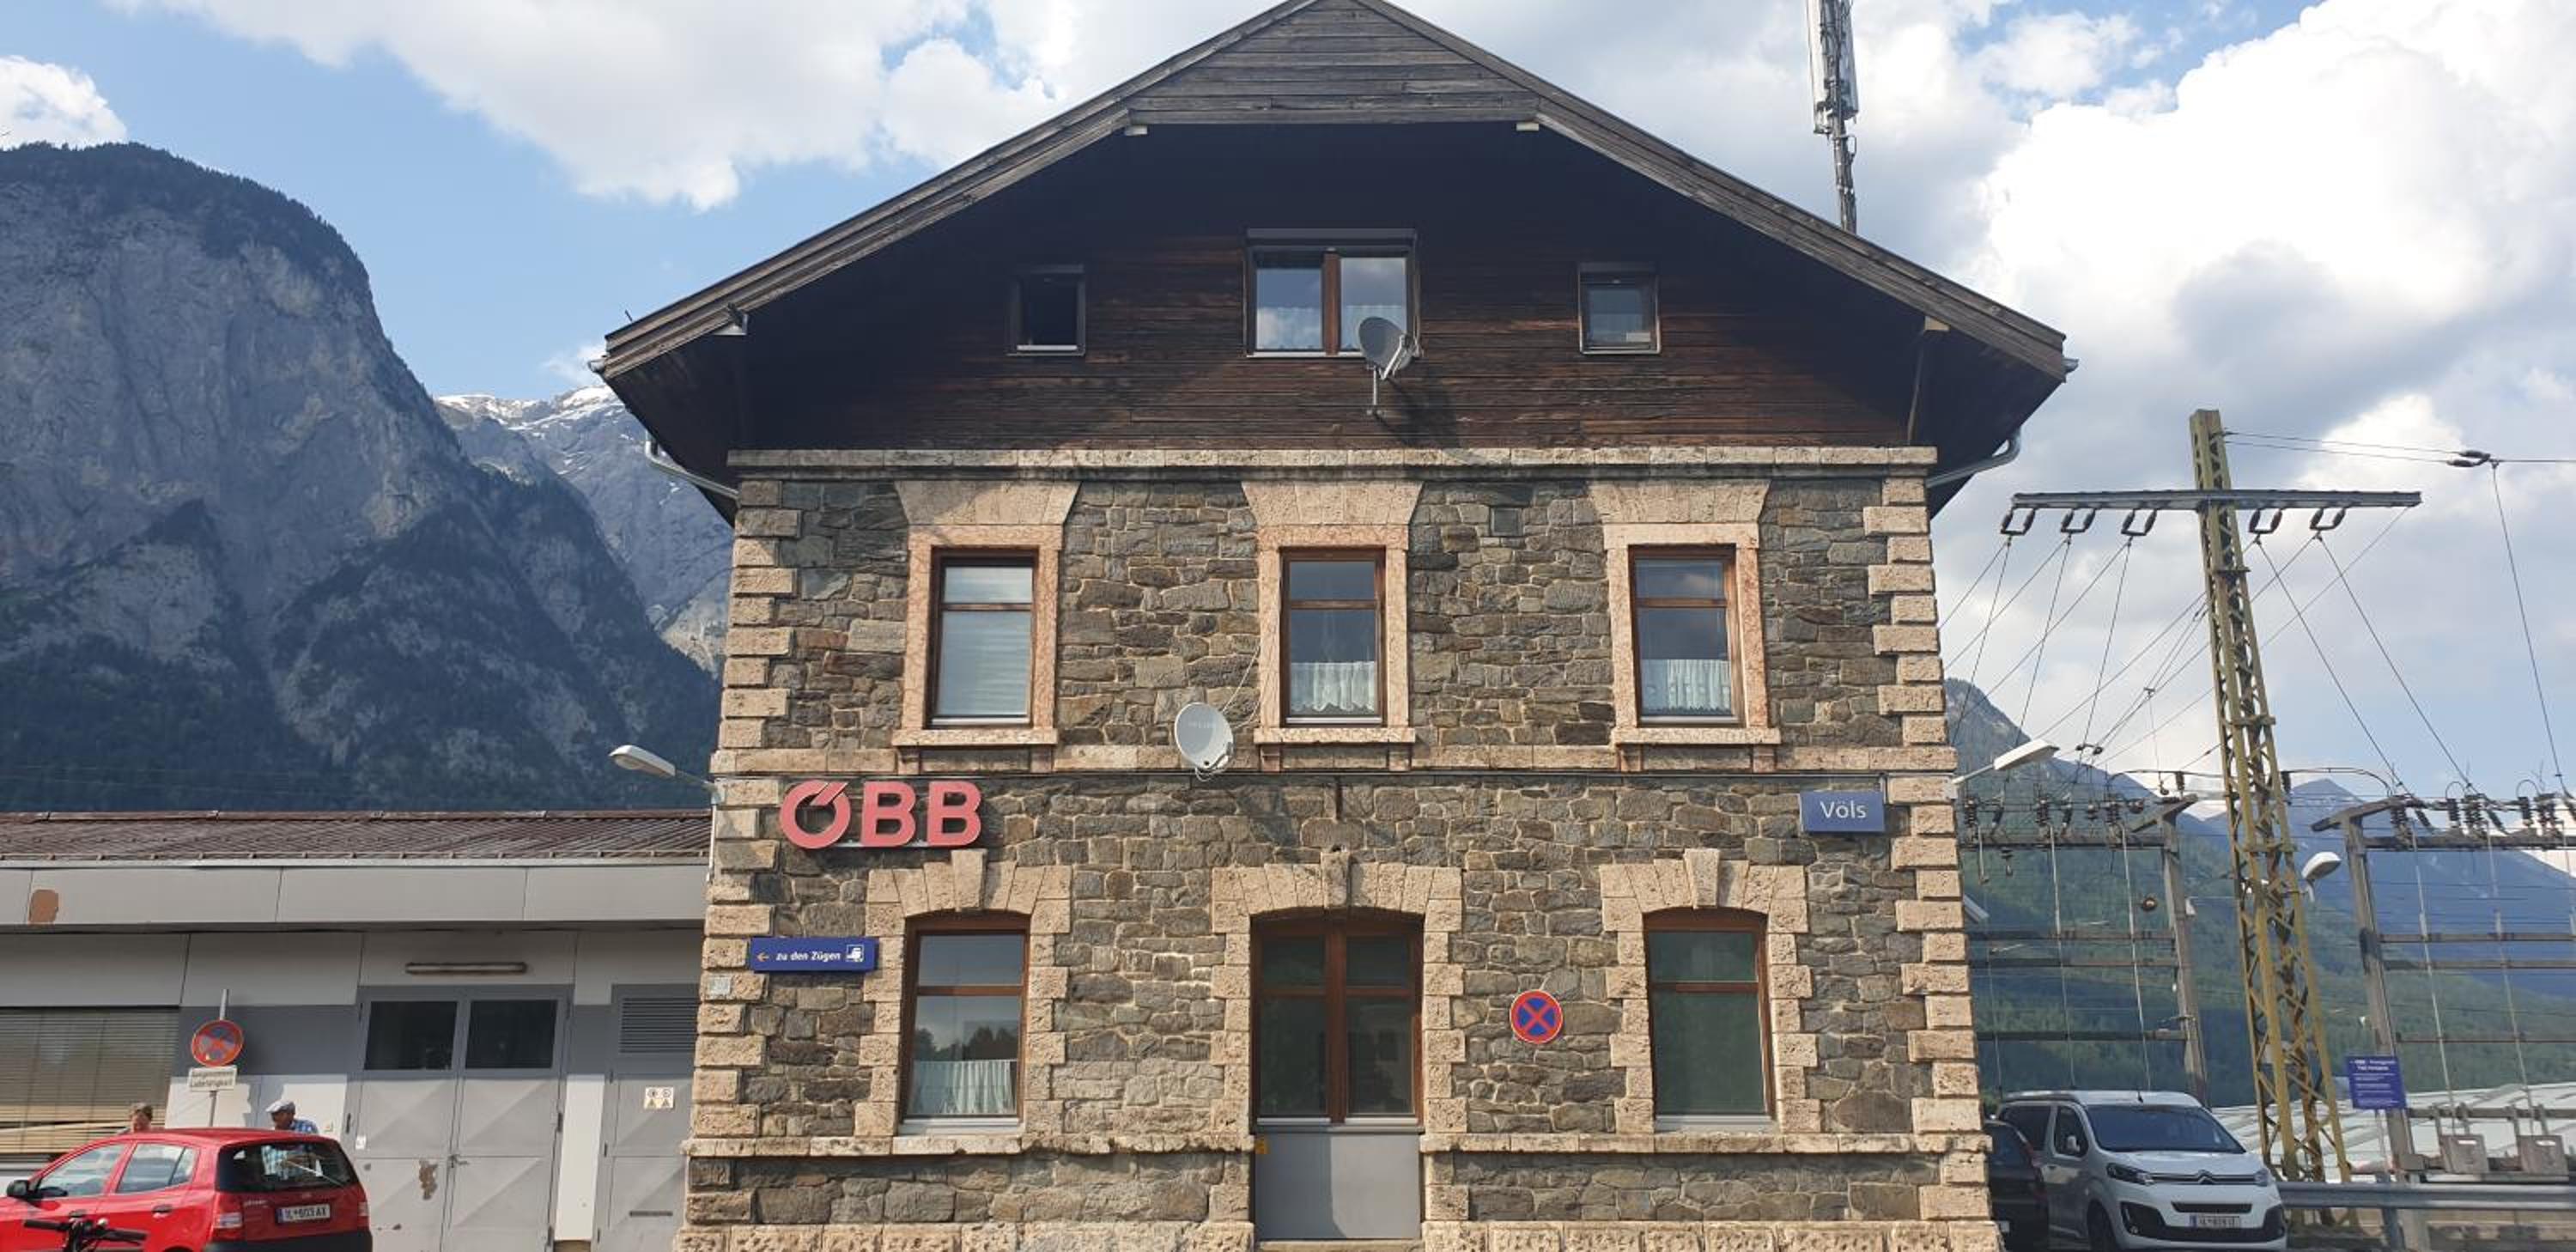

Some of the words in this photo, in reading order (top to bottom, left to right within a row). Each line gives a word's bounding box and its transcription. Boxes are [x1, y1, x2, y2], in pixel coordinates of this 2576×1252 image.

[780, 780, 981, 849] ÖBB
[1820, 800, 1867, 818] Völs
[775, 952, 787, 961] zu
[790, 951, 808, 961] den
[811, 950, 841, 963] Zügen
